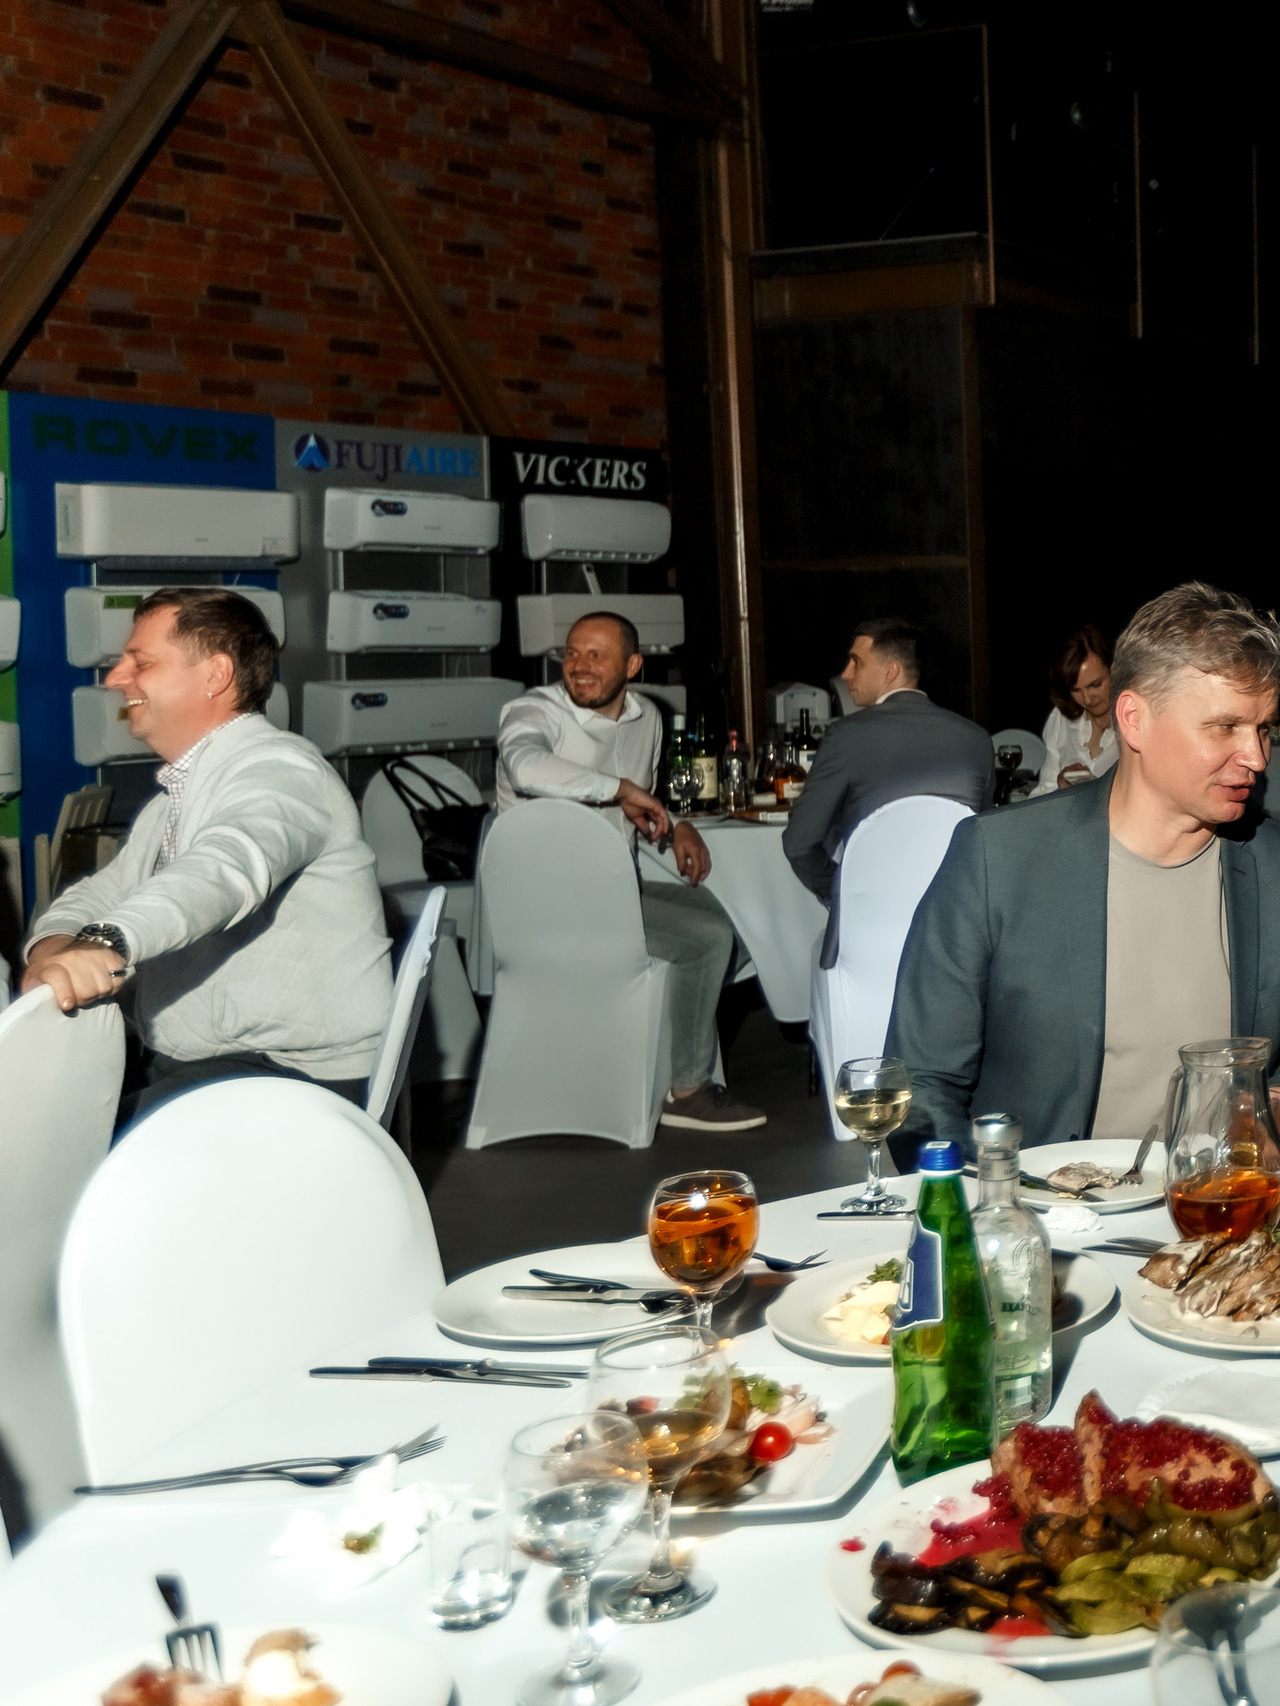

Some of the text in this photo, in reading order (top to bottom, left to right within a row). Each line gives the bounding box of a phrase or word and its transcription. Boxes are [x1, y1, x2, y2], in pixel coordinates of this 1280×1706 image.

[34, 414, 261, 465] ROVEX
[334, 438, 479, 483] FUJIAIRE
[513, 451, 647, 491] VICKERS
